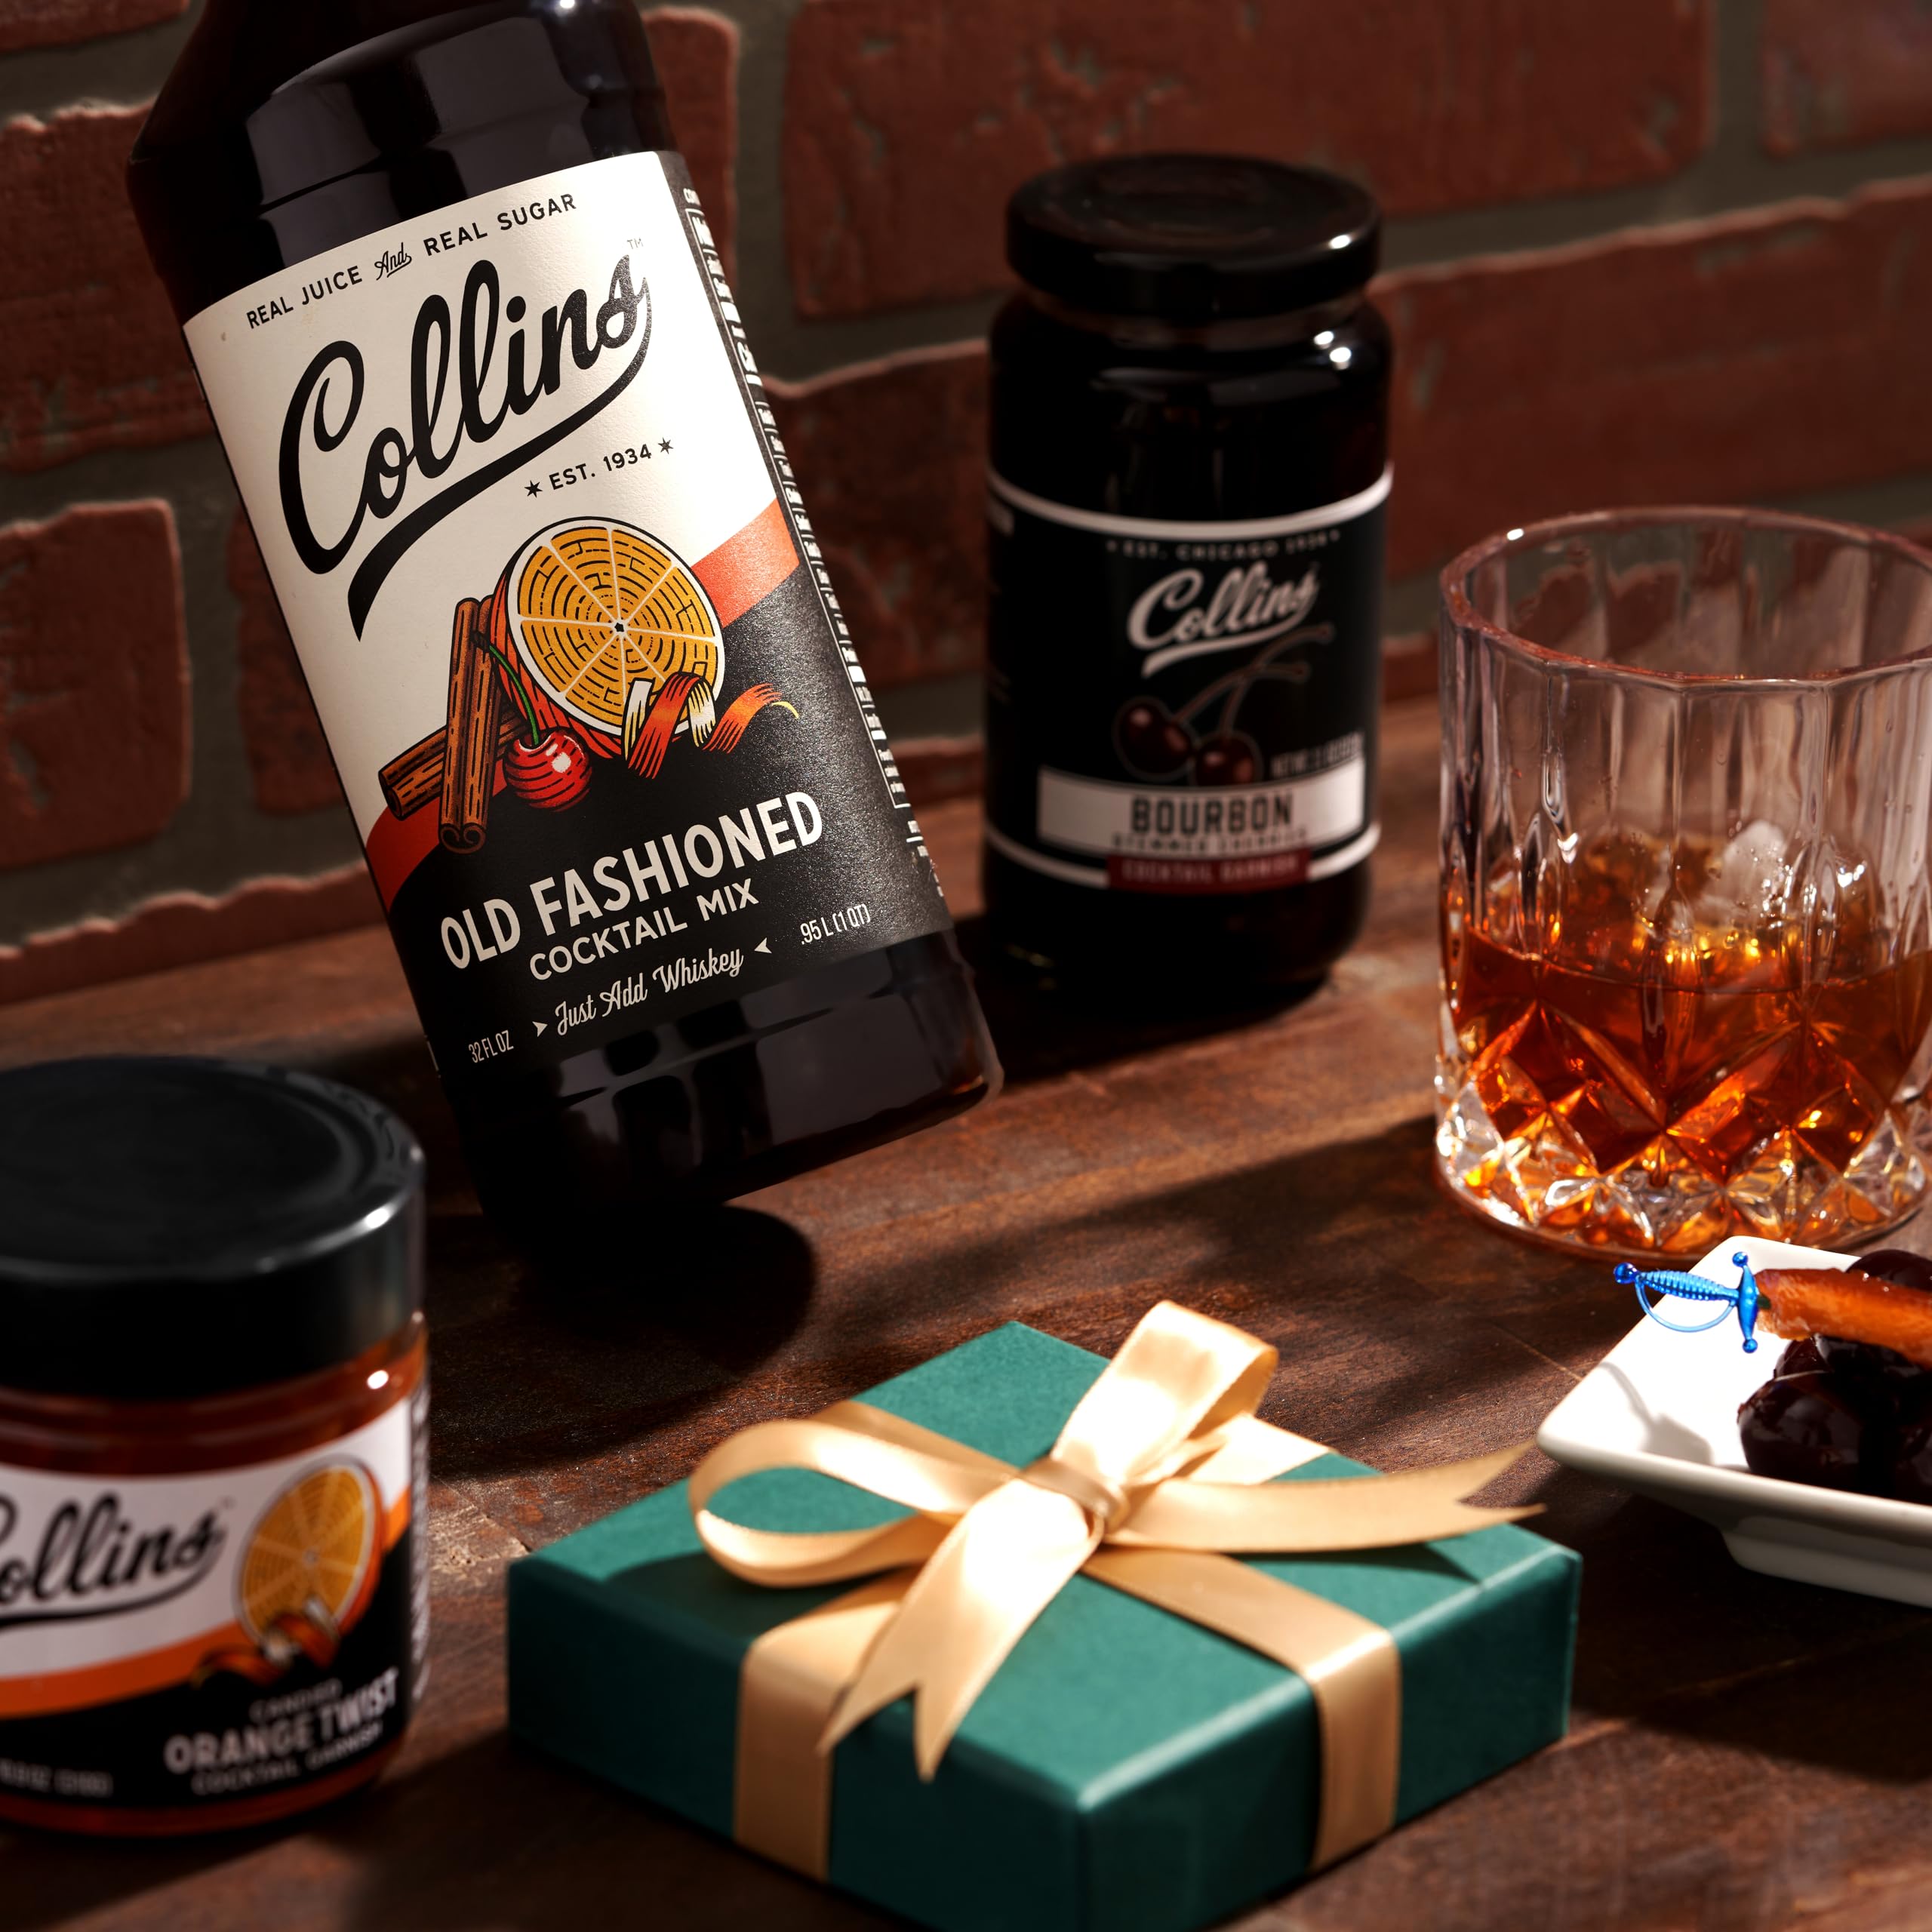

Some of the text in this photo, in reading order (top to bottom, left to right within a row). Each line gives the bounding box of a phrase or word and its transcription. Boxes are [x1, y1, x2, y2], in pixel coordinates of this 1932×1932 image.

[246, 193, 577, 330] REAL JUICE And REAL SUGAR
[278, 255, 651, 641] Collins
[549, 444, 653, 491] EST. 1934
[1175, 541, 1280, 562] CHICAGO
[1127, 558, 1321, 678] Collins
[1132, 795, 1293, 835] BOURBON
[441, 899, 521, 969] OLD
[530, 791, 823, 935] FASHIONED
[1121, 859, 1214, 884] COCKTAIL
[530, 878, 760, 980] COCKTAIL MIX
[800, 919, 823, 945] .95
[820, 917, 835, 937] L
[554, 947, 744, 1036] Just Add Whiskey
[468, 1029, 515, 1063] 32 FL OZ
[0, 1491, 226, 1634] ollins
[164, 1666, 399, 1774] ORANGE TWIST
